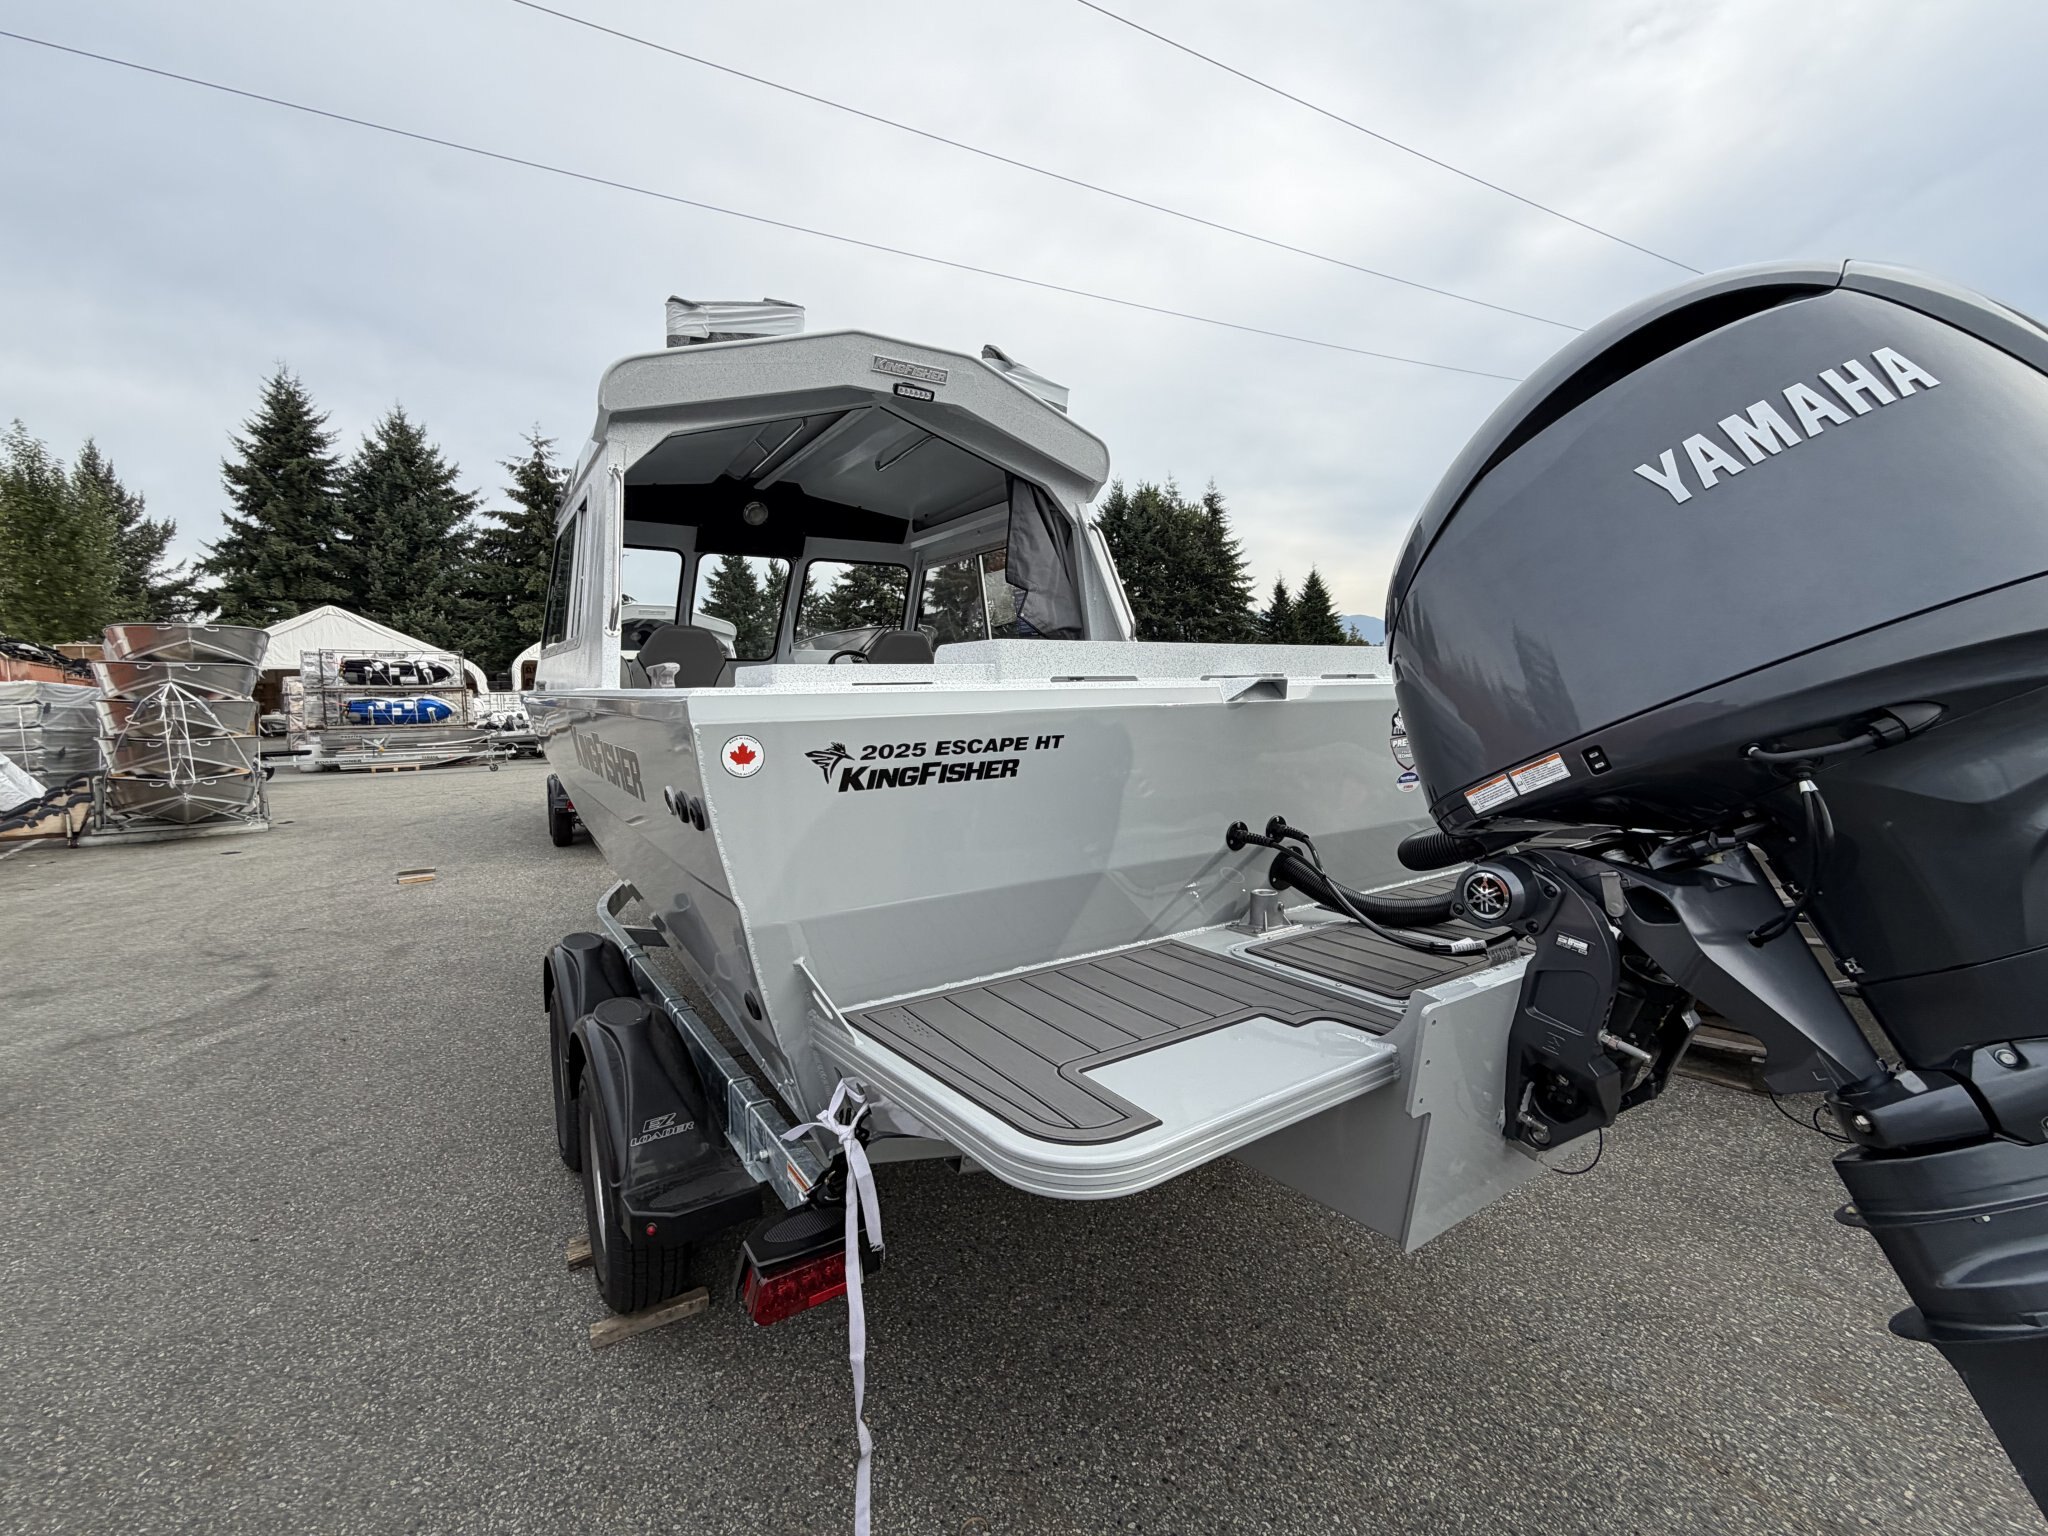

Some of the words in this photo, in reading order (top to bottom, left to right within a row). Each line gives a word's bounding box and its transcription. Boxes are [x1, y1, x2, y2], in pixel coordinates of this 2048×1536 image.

[1633, 346, 1942, 505] YAMAHA
[860, 742, 927, 761] 2025
[934, 737, 1030, 756] ESCAPE
[1035, 734, 1065, 750] HT
[630, 1121, 695, 1147] LOADER
[642, 1112, 677, 1133] EZ
